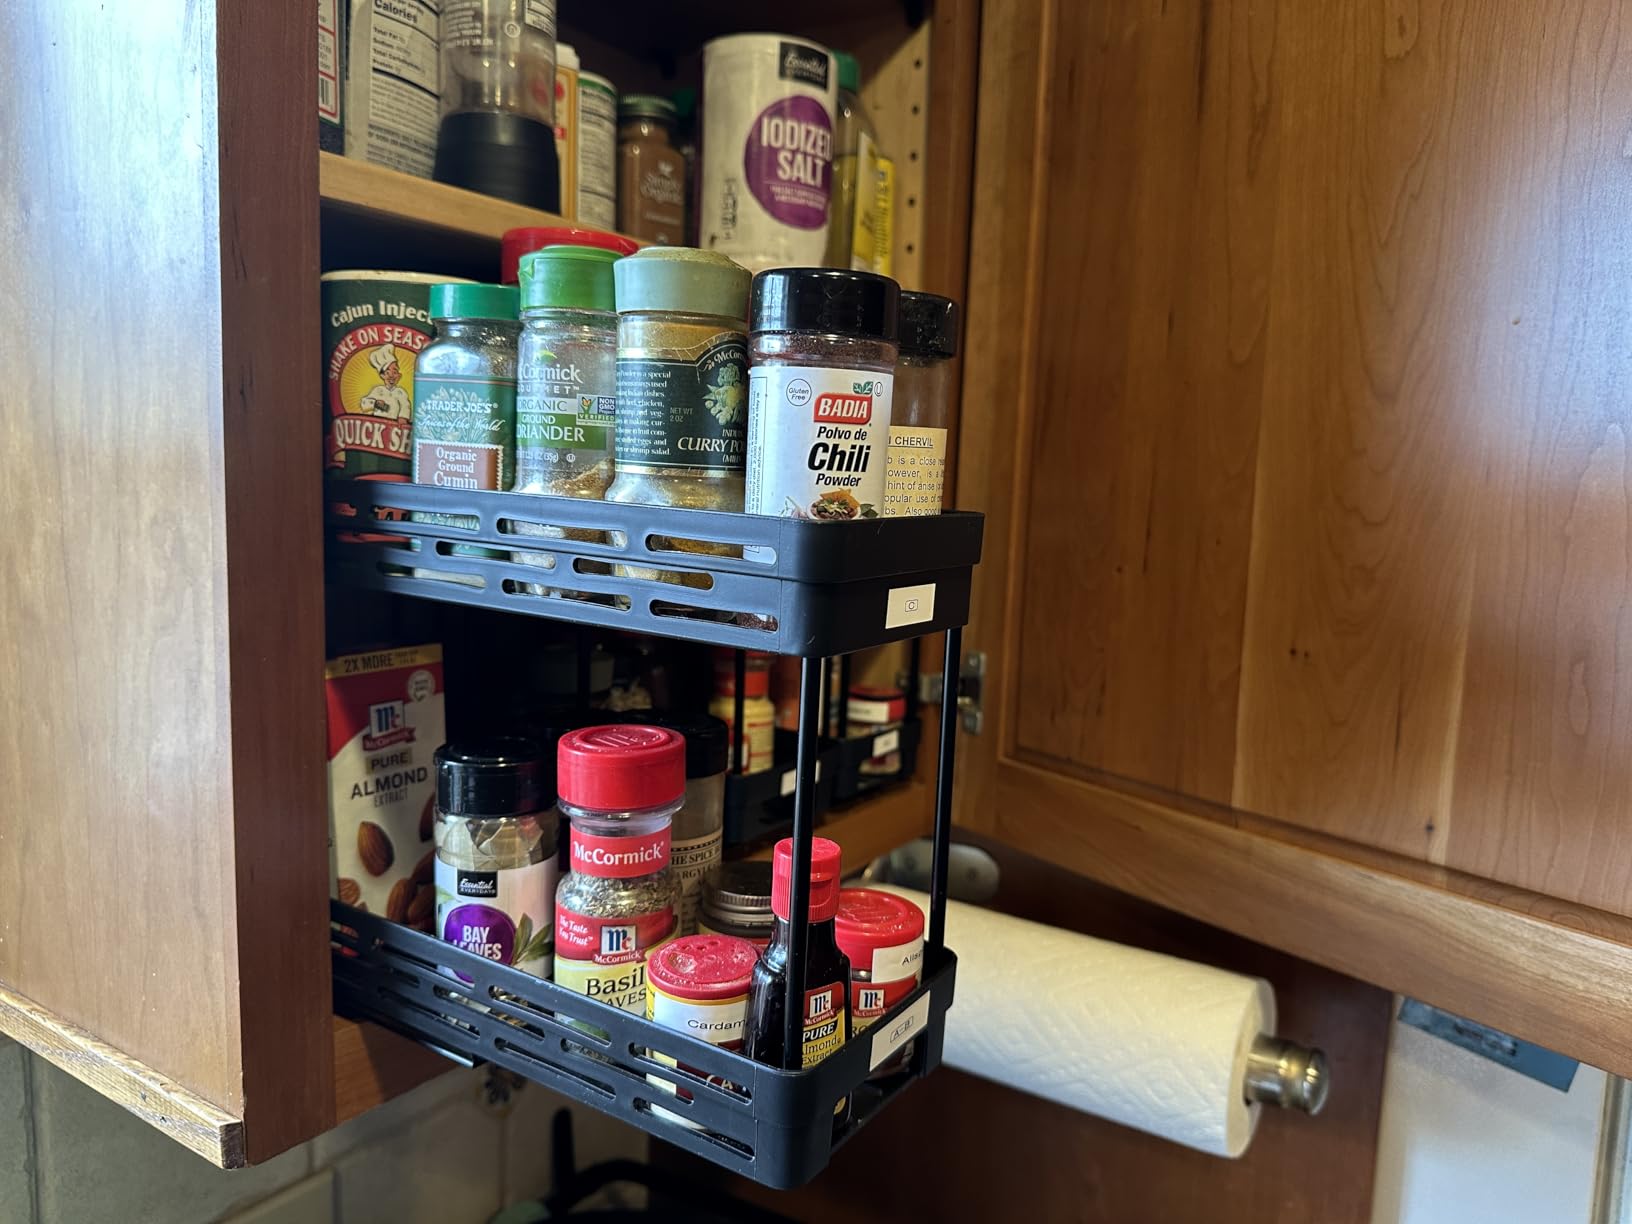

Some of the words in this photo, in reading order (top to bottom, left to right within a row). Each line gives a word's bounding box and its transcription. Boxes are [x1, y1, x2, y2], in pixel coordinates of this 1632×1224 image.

[374, 0, 417, 23] Calories
[761, 116, 833, 161] IODIZED
[777, 150, 825, 188] SALT
[331, 303, 374, 327] Cajun
[329, 335, 357, 380] SHAKE
[357, 327, 379, 345] ON
[383, 326, 428, 350] SEAS
[520, 363, 583, 384] Cormick
[788, 387, 809, 395] Gluten
[426, 399, 463, 412] TRADER
[464, 402, 492, 414] JOE'S
[599, 397, 615, 405] NON
[818, 398, 868, 418] BADIA
[579, 413, 615, 421] VERIFIED
[669, 407, 682, 415] NET
[522, 414, 556, 425] GROUND
[335, 419, 386, 449] QUICK
[817, 426, 851, 440] Polvo
[854, 428, 867, 440] de
[677, 437, 729, 452] CURRY
[895, 436, 933, 447] CHERVIL
[436, 447, 477, 462] Organic
[808, 442, 871, 472] Chili
[898, 456, 906, 465] is
[910, 457, 916, 465] a
[920, 457, 937, 466] close
[438, 460, 475, 474] Ground
[434, 471, 478, 489] Cumin
[816, 473, 861, 487] Powder
[887, 481, 905, 490] hint
[907, 481, 916, 490] of
[918, 482, 935, 491] anise
[905, 506, 921, 516] Also
[908, 601, 915, 610] C
[344, 657, 360, 673] 2X
[362, 653, 394, 669] MORE
[371, 752, 409, 770] PURE
[351, 767, 428, 800] ALMOND
[573, 841, 662, 866] McCormick
[460, 878, 494, 889] Essential
[463, 925, 490, 943] BAY
[453, 939, 502, 960] EAVES
[594, 950, 641, 964] McCormick
[902, 952, 921, 966] Alls
[586, 965, 645, 997] Basil
[606, 991, 647, 1010] AVES
[804, 1009, 836, 1025] McCormick
[853, 1008, 888, 1017] McCormick
[802, 1022, 835, 1043] PURE
[804, 1034, 838, 1055] lmond
